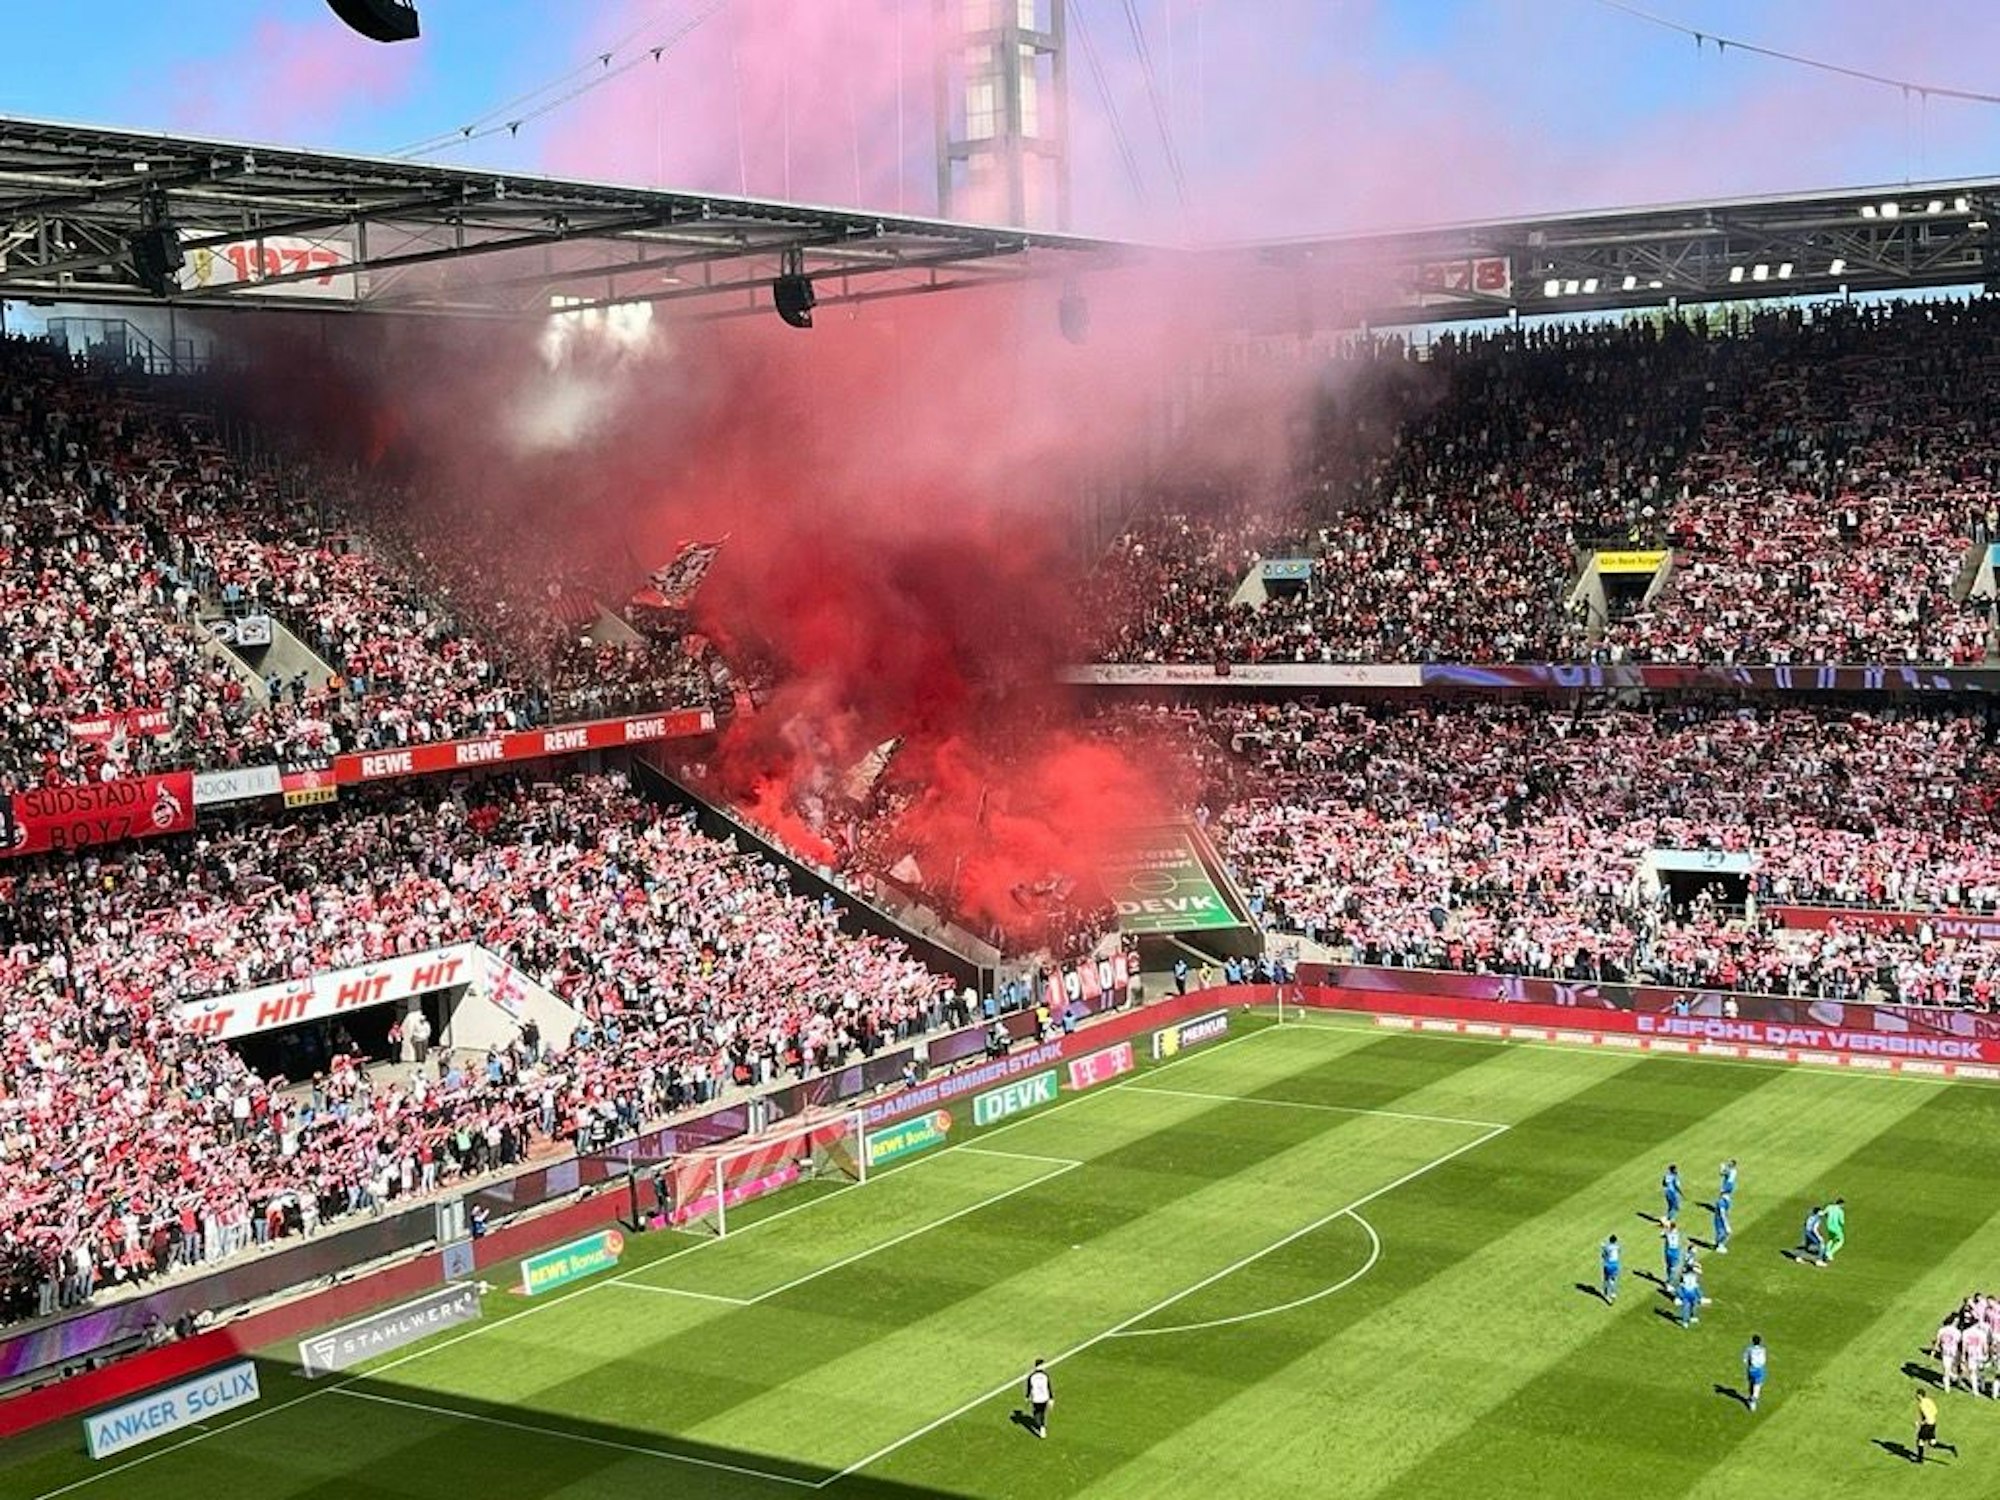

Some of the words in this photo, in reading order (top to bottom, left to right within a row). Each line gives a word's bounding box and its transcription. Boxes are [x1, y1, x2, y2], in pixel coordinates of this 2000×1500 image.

[228, 245, 340, 286] 1977
[362, 751, 413, 778] REWE
[456, 738, 505, 764] REWE
[543, 727, 588, 752] REWE
[625, 717, 666, 740] REWE
[24, 780, 149, 818] SÜDSTADT
[50, 816, 132, 849] BOYZ
[1117, 896, 1220, 914] DEVK
[256, 992, 312, 1027] HIT
[336, 975, 390, 1007] HIT
[410, 958, 464, 991] HIT
[1182, 1015, 1228, 1048] MERKUR
[1637, 1016, 1655, 1031] E
[1657, 1017, 1761, 1044] JEFÖHL
[1766, 1027, 1827, 1048] DAT
[938, 1062, 1009, 1098] SIMMER
[1009, 1044, 1063, 1074] STARK
[985, 1076, 1050, 1121] DEVK
[872, 1135, 905, 1157] REWE
[530, 1258, 570, 1286] REWE
[98, 1404, 178, 1450] ANKER
[186, 1368, 255, 1414] SOLIX
